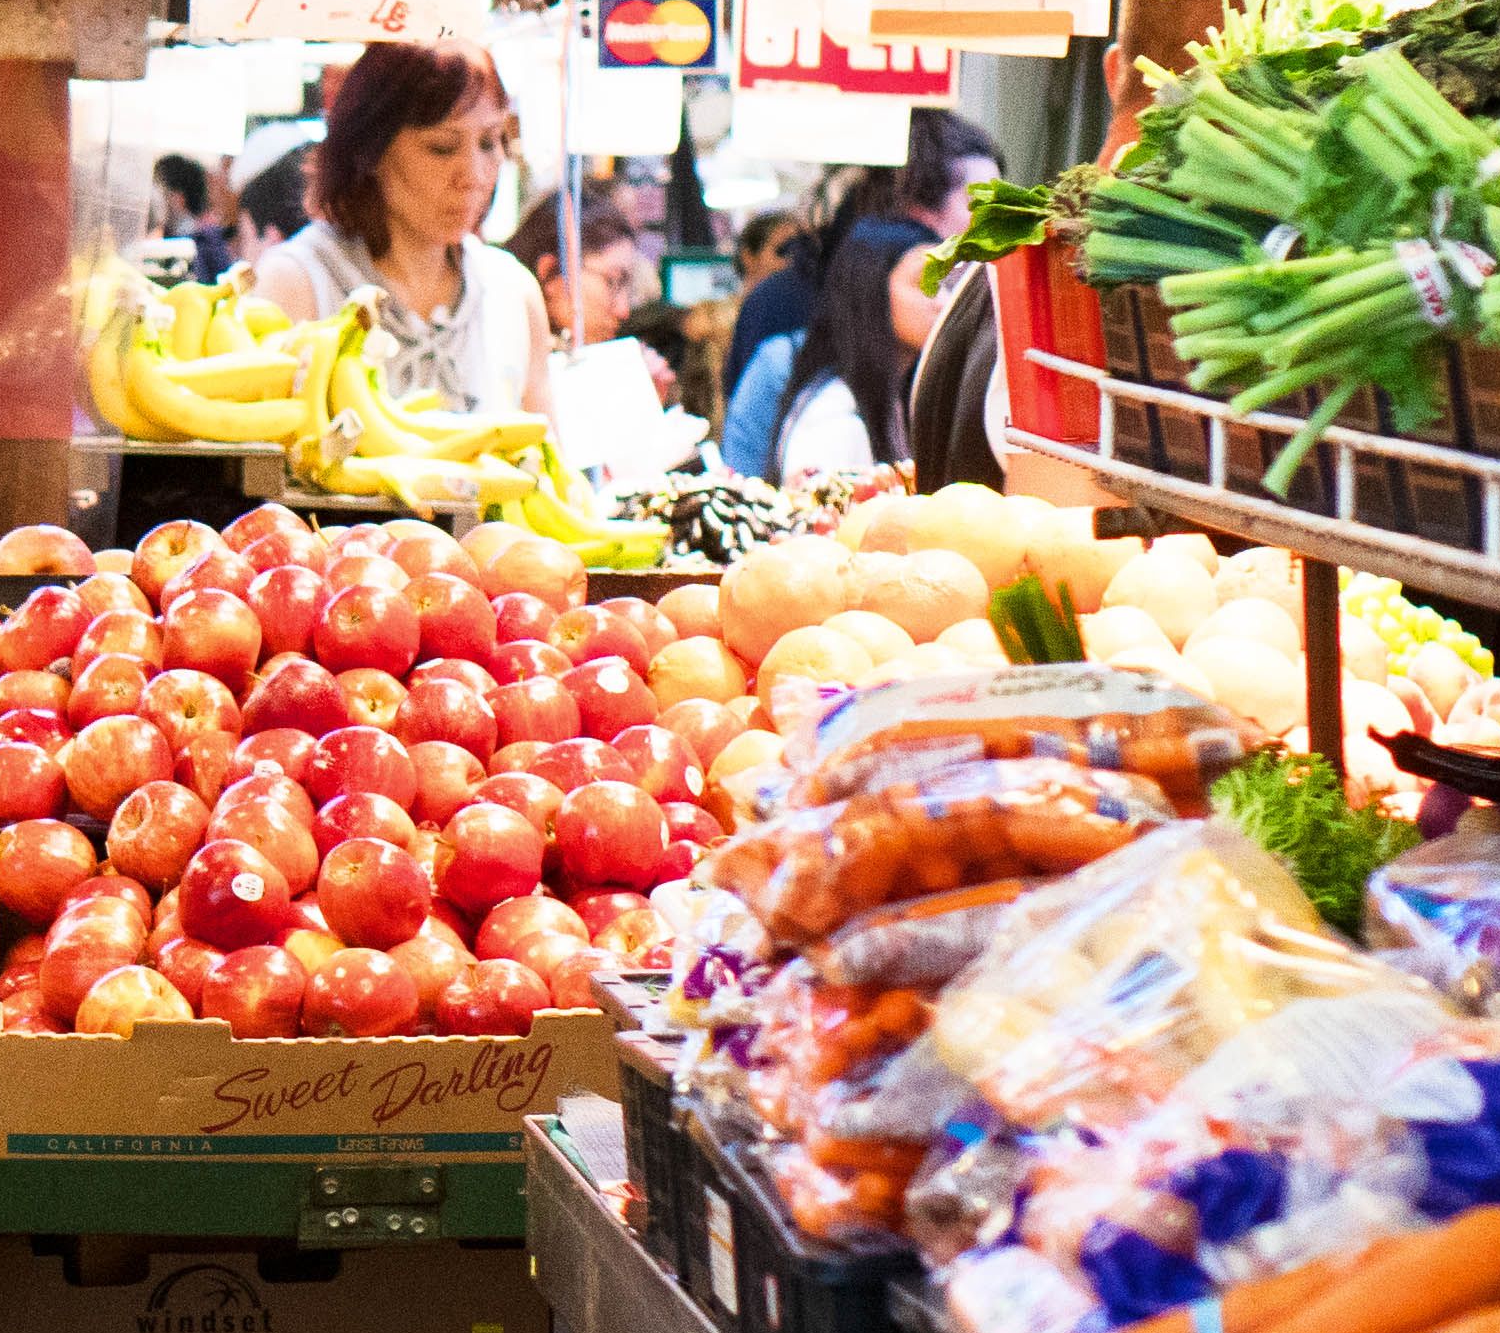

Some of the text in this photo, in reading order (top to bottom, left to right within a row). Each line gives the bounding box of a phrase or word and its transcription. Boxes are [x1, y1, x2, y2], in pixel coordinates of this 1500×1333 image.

[200, 1041, 554, 1134] Sweet Darling
[46, 1137, 215, 1153] CALIFORNIA
